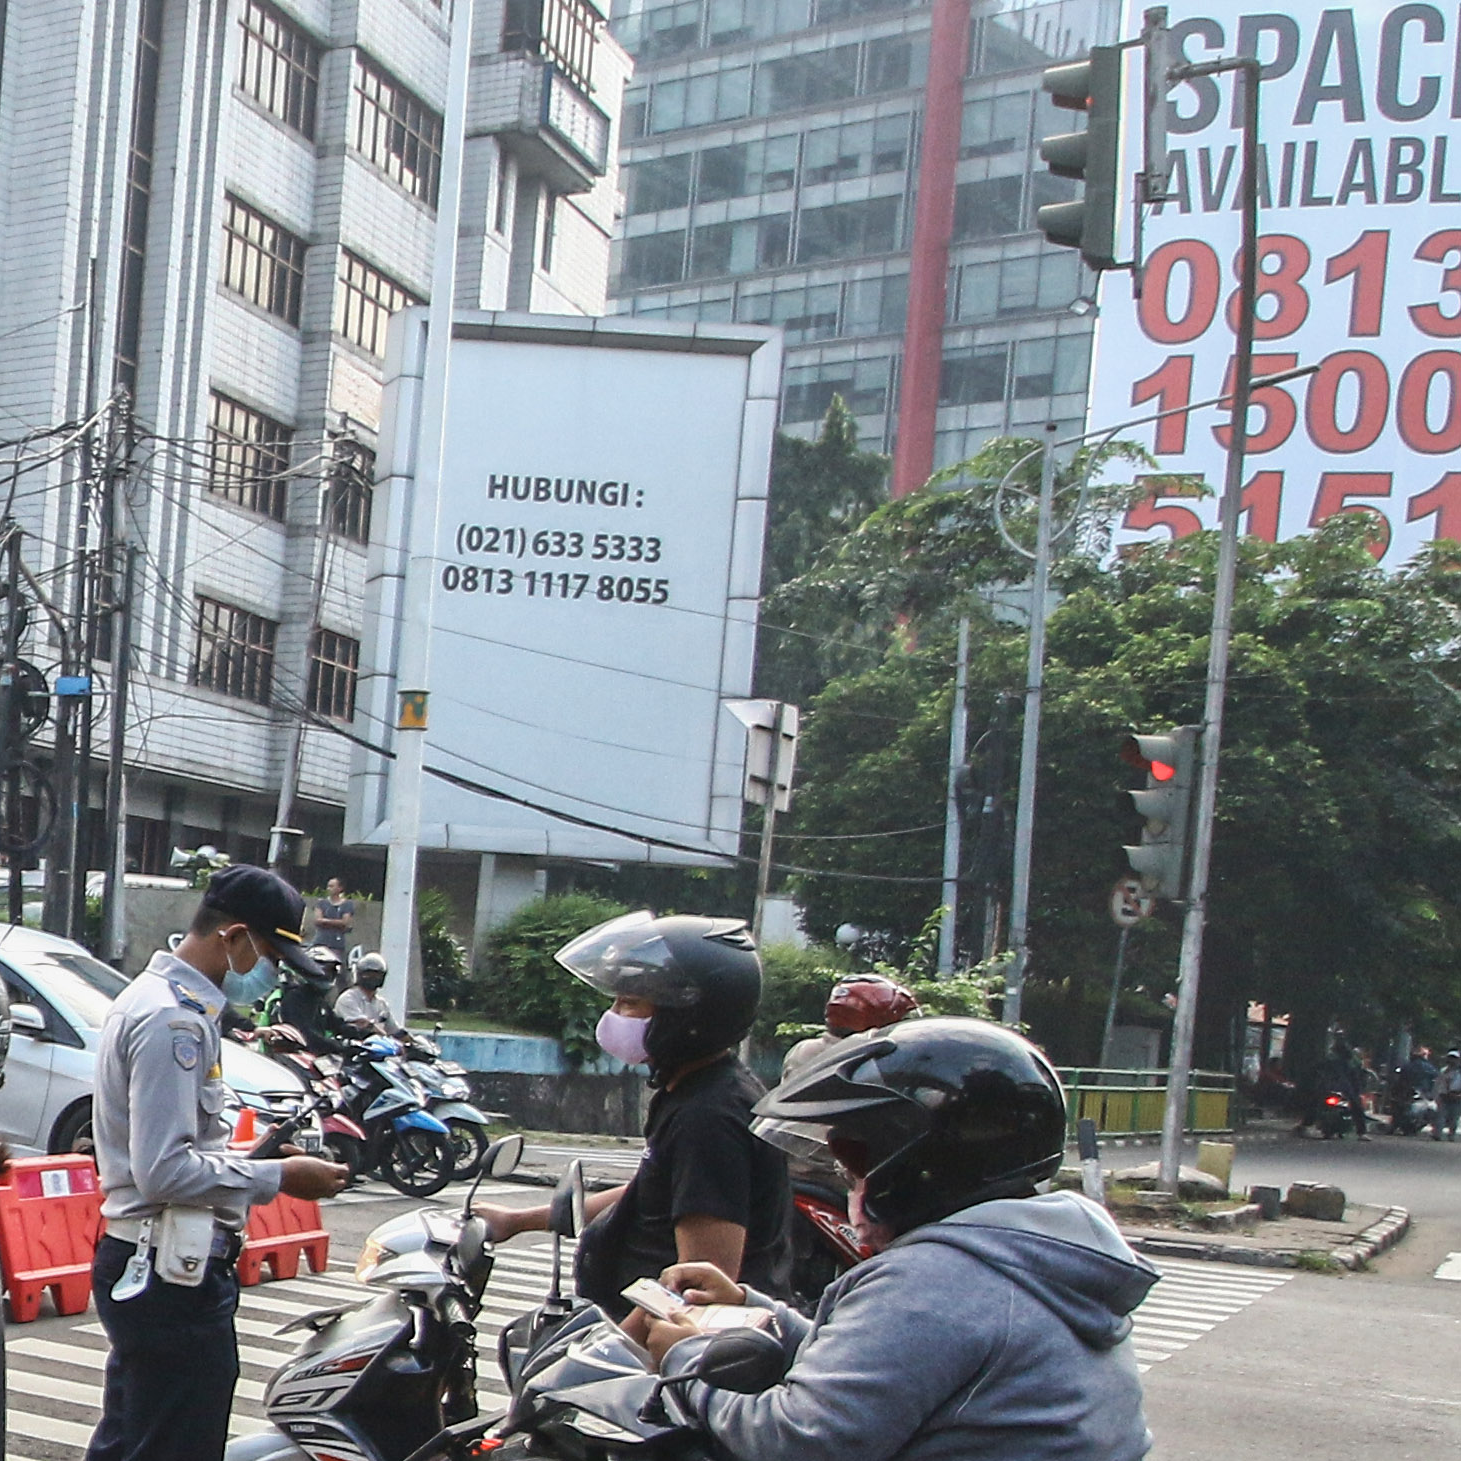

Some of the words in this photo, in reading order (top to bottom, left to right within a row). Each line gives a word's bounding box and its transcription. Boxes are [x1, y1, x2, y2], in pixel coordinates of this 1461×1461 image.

[1166, 3, 1461, 136] SPAC
[1137, 229, 1461, 345] 0813
[1131, 349, 1461, 456] 1500
[488, 474, 628, 507] HUBUNGI
[456, 523, 527, 558] (021)
[532, 531, 584, 558] 633
[592, 534, 661, 563] 5333
[442, 565, 513, 594] 0813
[524, 571, 589, 599] 1117
[597, 576, 669, 604] 8055
